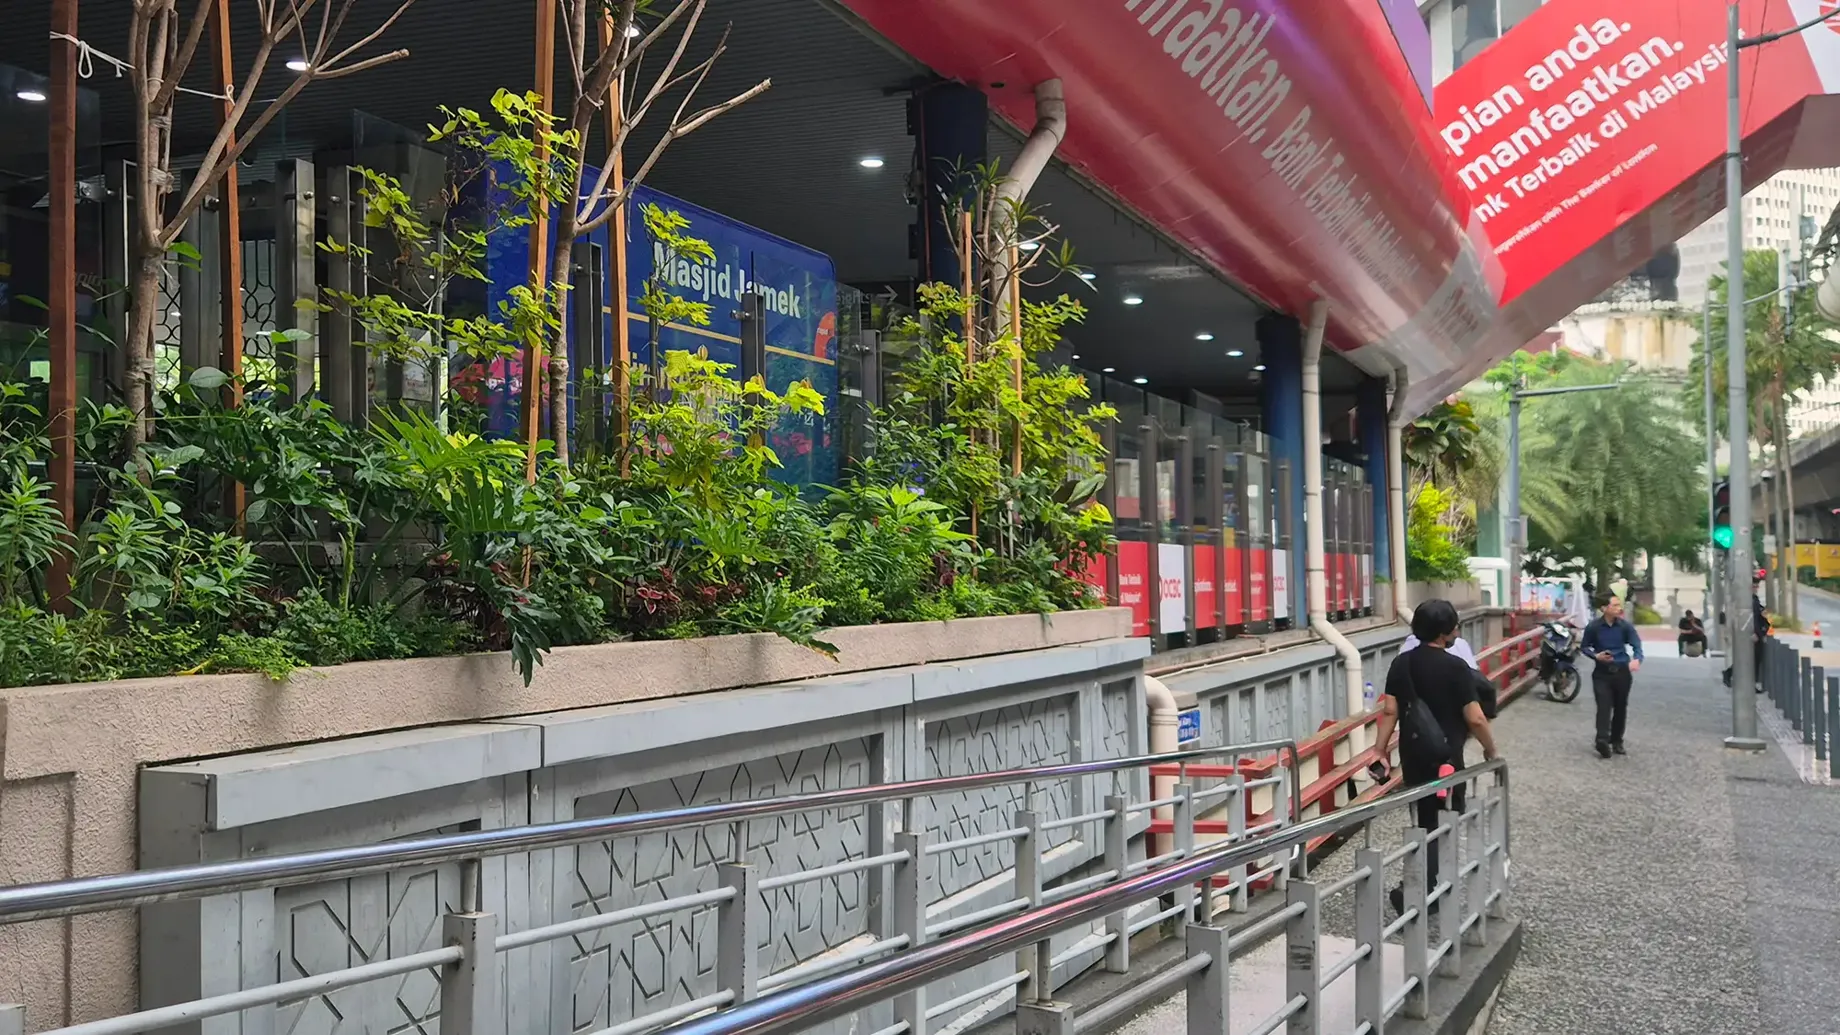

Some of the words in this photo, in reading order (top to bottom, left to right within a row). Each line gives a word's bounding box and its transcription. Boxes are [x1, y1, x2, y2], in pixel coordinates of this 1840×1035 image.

[1440, 84, 1524, 157] pian
[1524, 17, 1631, 92] anda.
[1457, 36, 1684, 191] manfaatkan.
[1262, 105, 1334, 191] Bank
[1474, 192, 1510, 223] nk
[1503, 132, 1600, 199] Terbaik
[1599, 109, 1629, 139] di
[1560, 194, 1580, 210] The
[1578, 173, 1612, 198] Banker
[654, 242, 731, 302] Masjid
